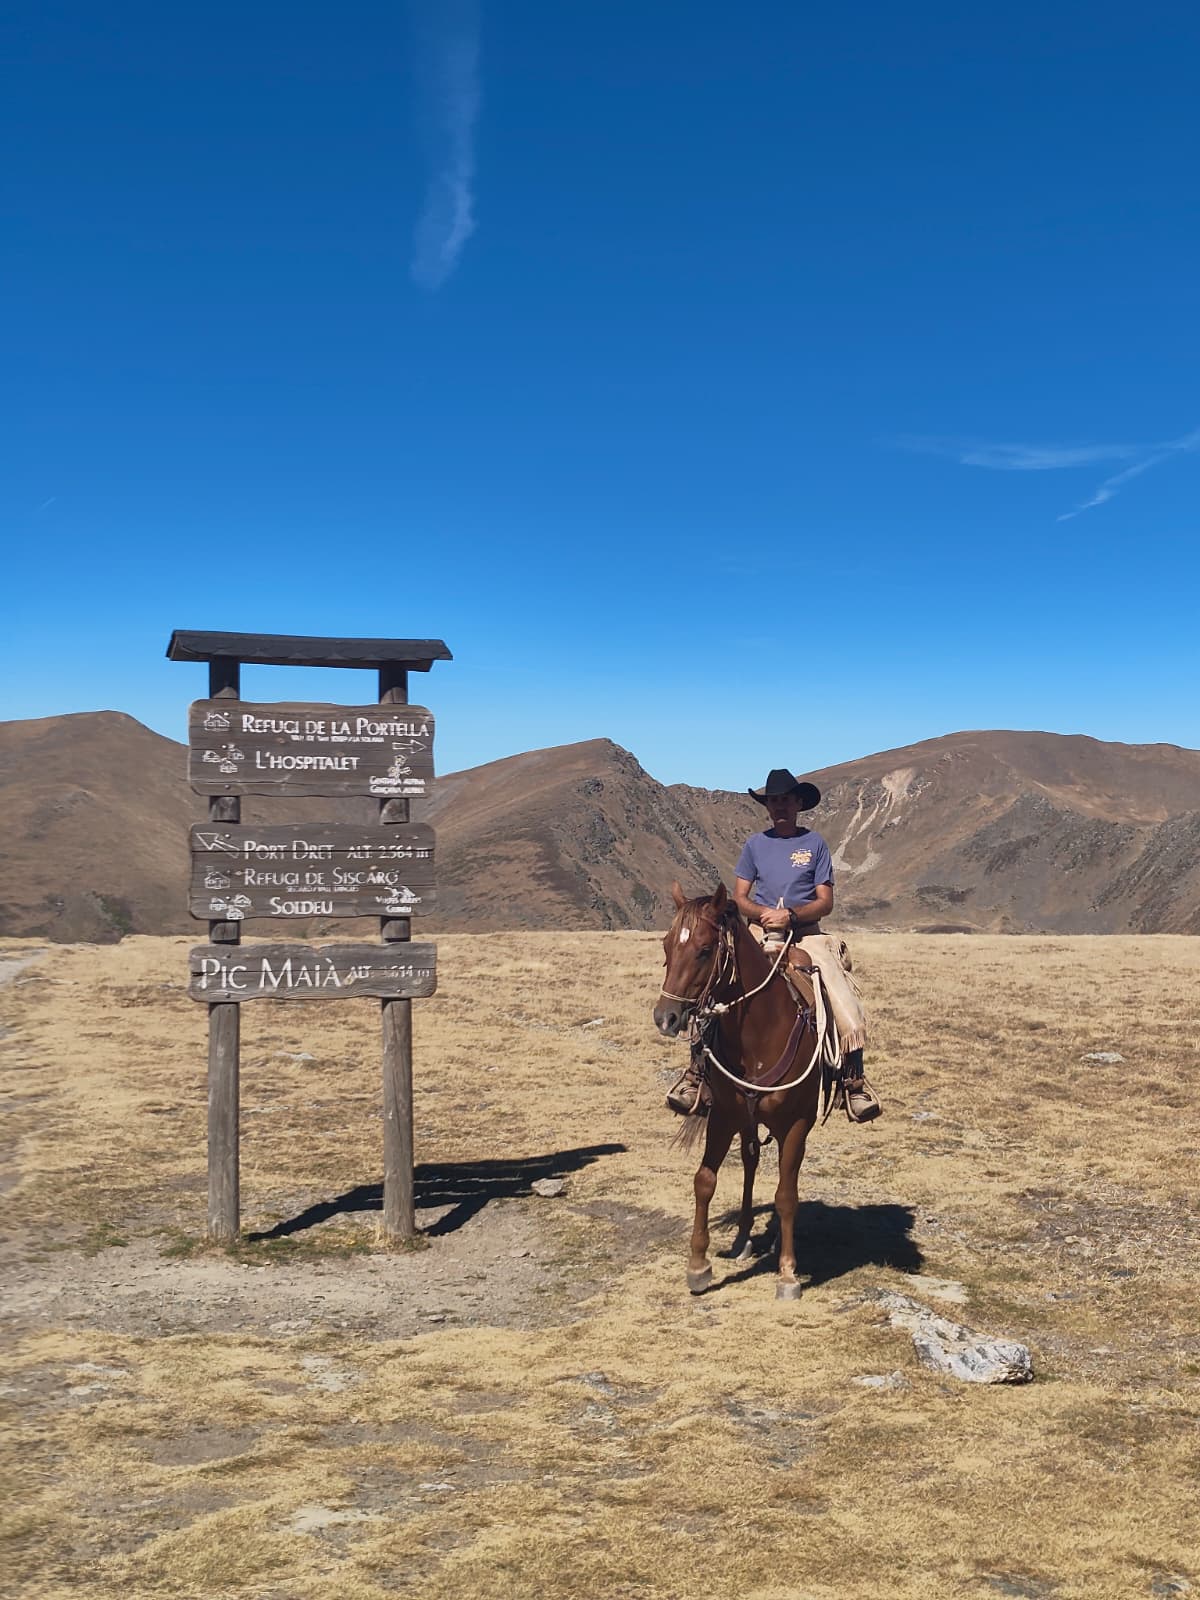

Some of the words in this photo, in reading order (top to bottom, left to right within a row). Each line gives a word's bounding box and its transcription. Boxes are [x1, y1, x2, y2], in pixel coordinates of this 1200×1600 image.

[242, 714, 298, 734] REFUGI
[305, 720, 326, 735] DE
[331, 720, 351, 736] LA
[356, 717, 430, 737] PORTELLA
[255, 751, 360, 770] L'HOSPITALET
[243, 840, 287, 860] PORT
[293, 840, 335, 860] DRET
[244, 867, 299, 885] REFUGI
[305, 872, 325, 885] DE
[269, 896, 333, 915] SOLDEU
[199, 958, 247, 989] PIC
[259, 957, 341, 989] MAIÀ
